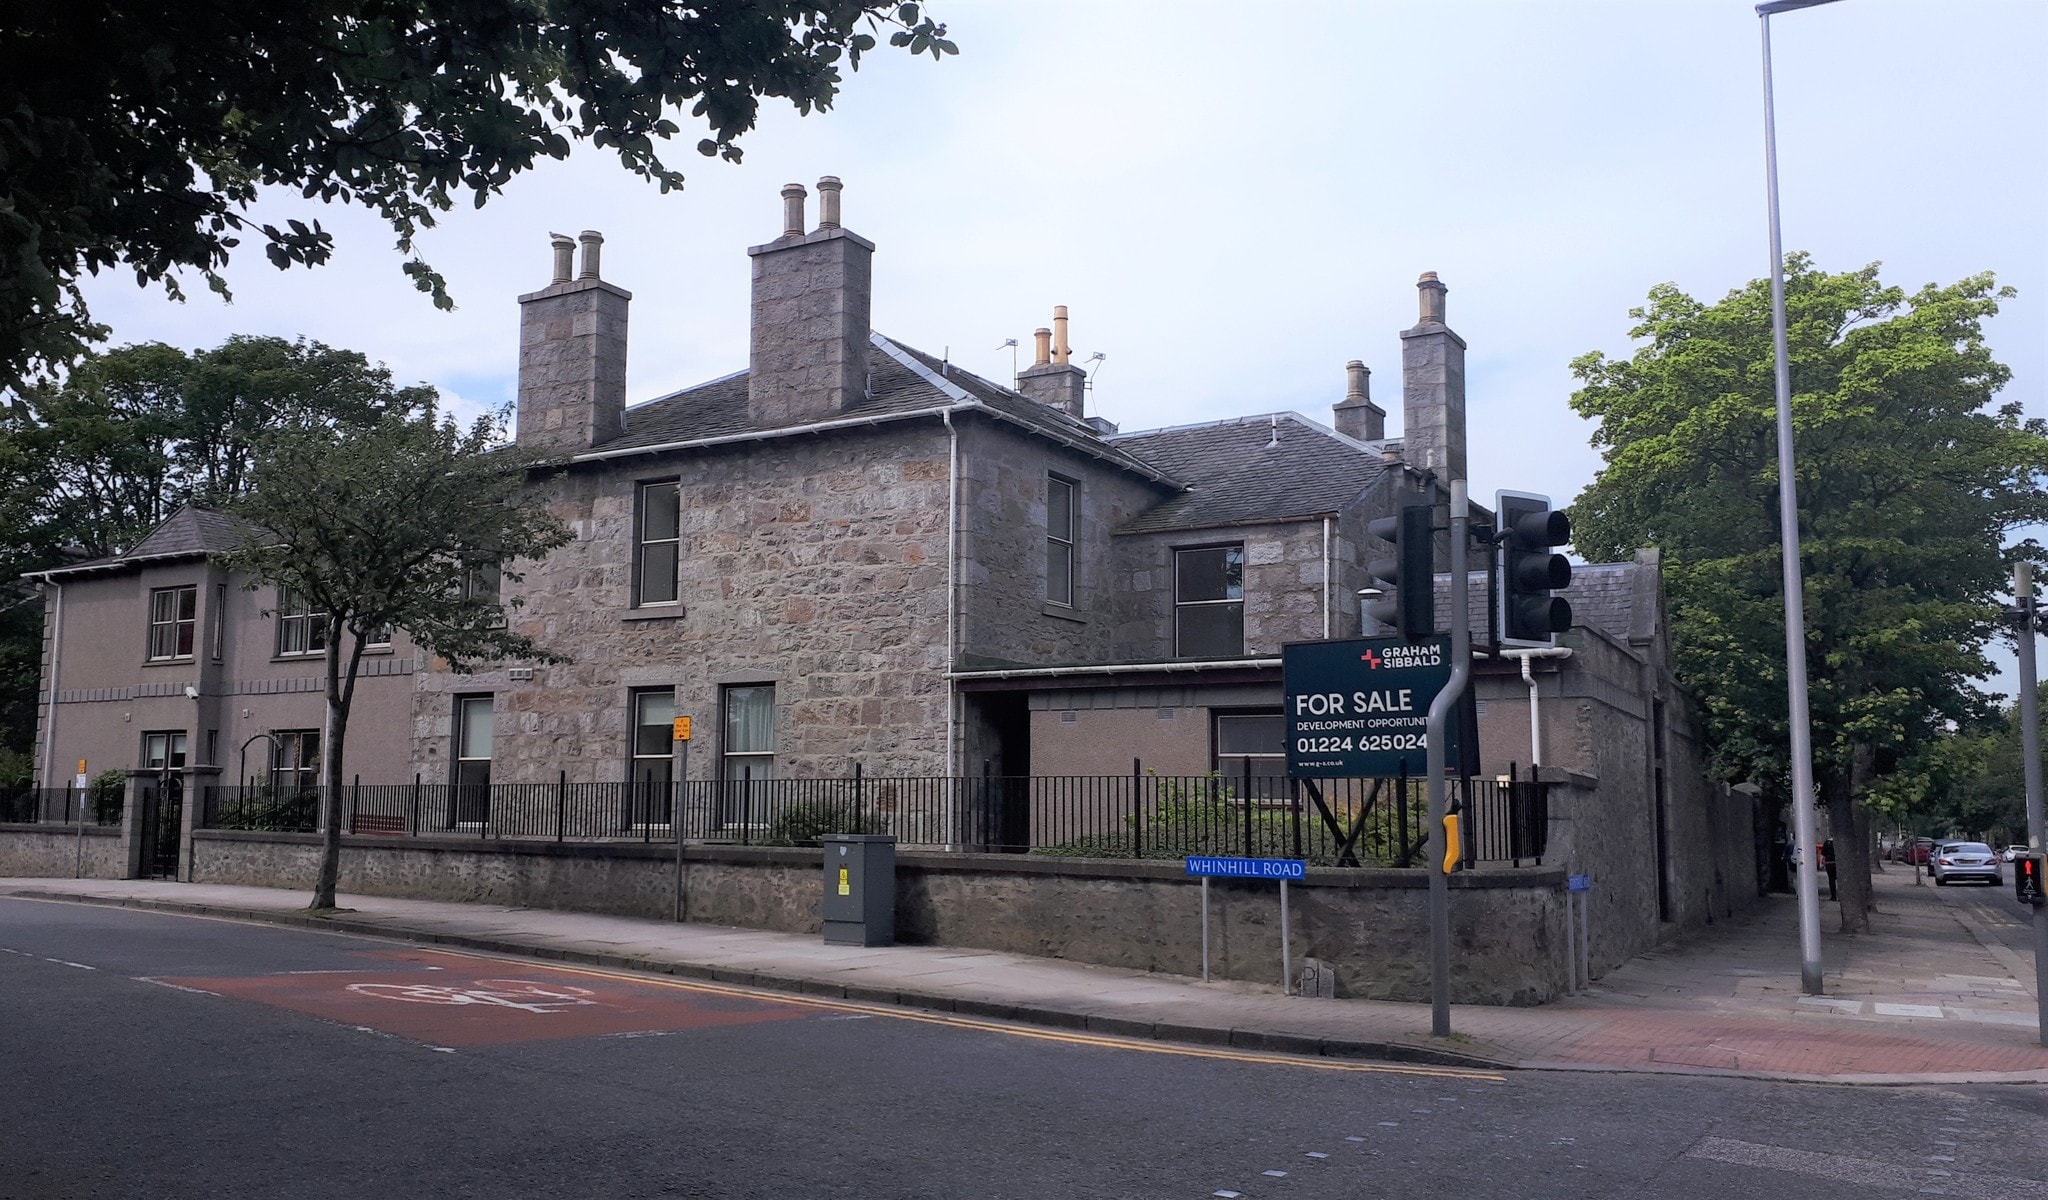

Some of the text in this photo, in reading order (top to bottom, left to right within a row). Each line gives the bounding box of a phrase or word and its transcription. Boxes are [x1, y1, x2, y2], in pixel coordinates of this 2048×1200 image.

[1382, 644, 1441, 658] GRAHAM
[1383, 655, 1441, 669] SIBBALD
[1296, 688, 1413, 716] FOR SALE
[1296, 716, 1429, 731] DEVELOPMENT OPPORTUNIT
[1297, 733, 1428, 753] 01224 625024
[1189, 859, 1302, 876] WHINHILL ROAD
